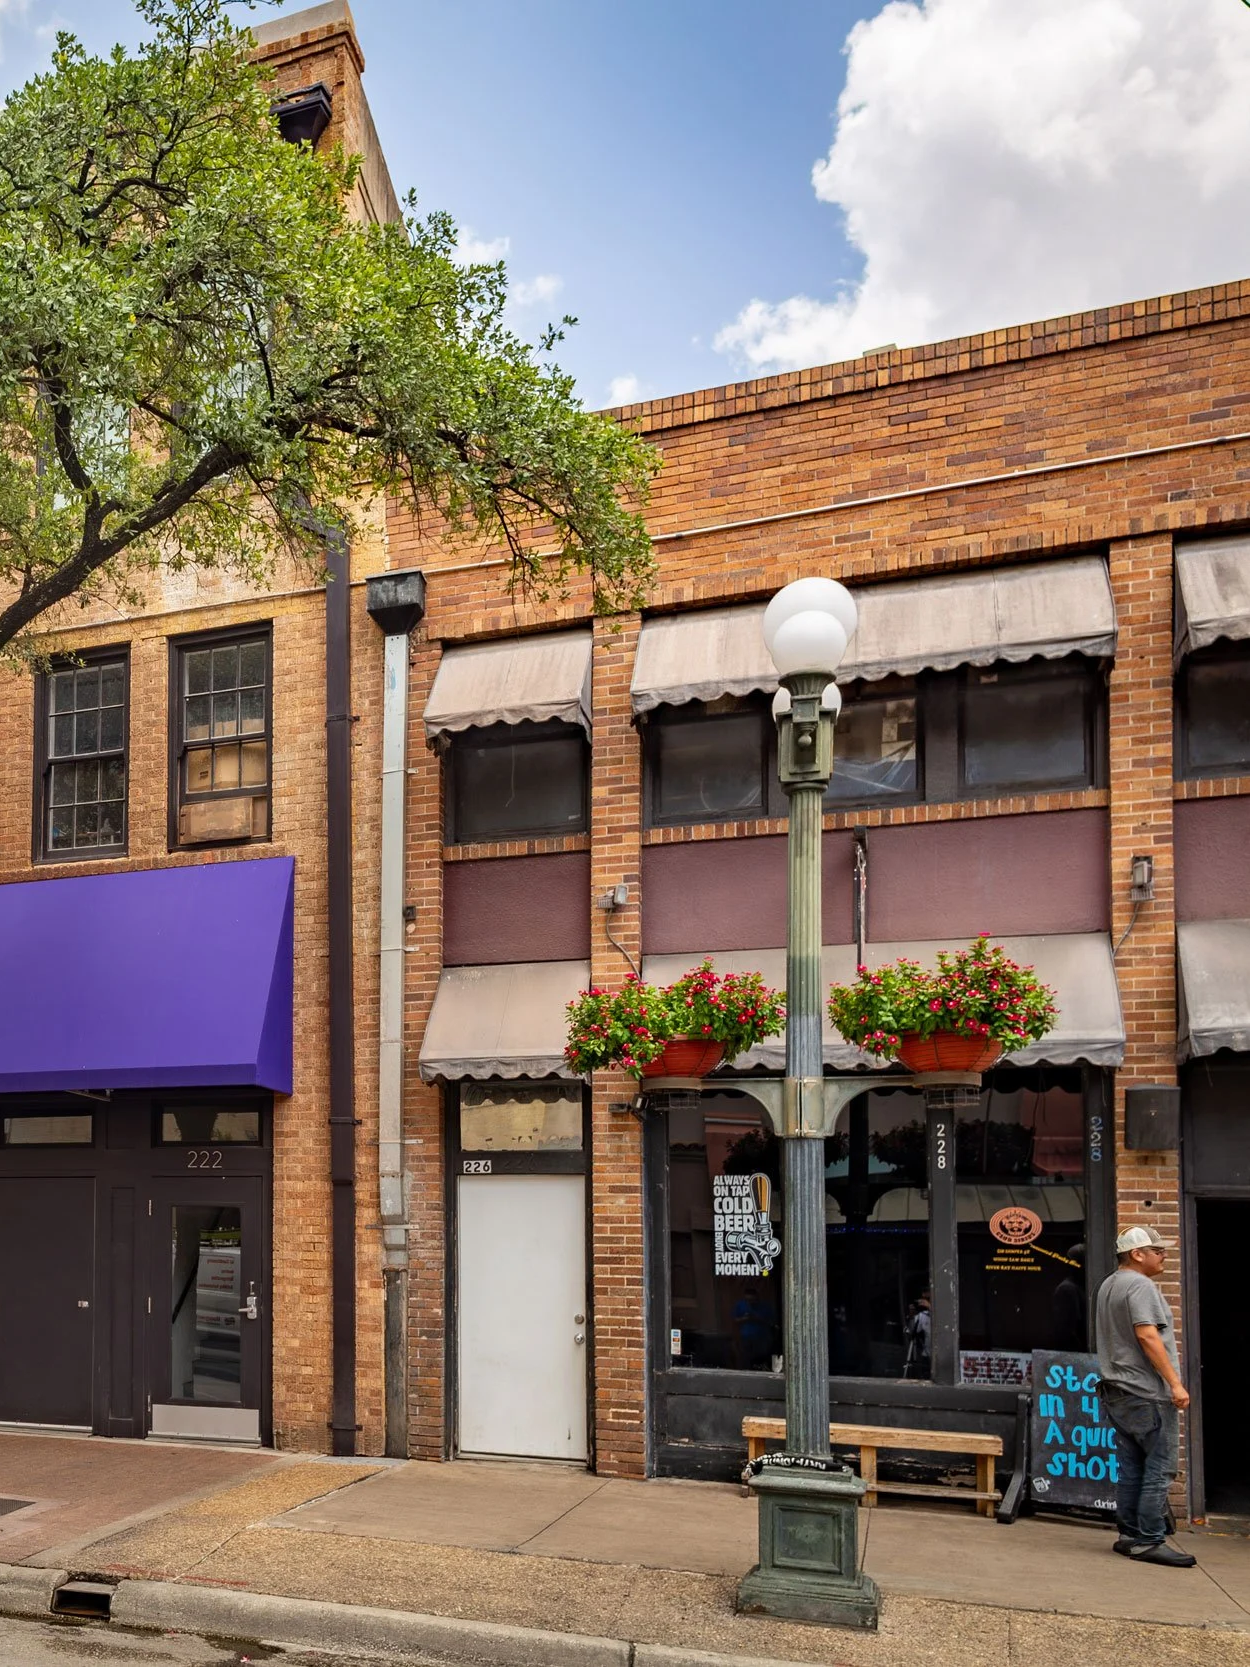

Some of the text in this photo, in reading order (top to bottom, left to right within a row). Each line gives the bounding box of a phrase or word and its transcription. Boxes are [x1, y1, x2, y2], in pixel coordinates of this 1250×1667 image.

[937, 1124, 946, 1169] 228
[187, 1150, 223, 1169] 222
[464, 1161, 490, 1173] 226
[713, 1175, 750, 1186] ALWAYS
[713, 1186, 750, 1197] ON TAP
[713, 1197, 753, 1214] COLD
[714, 1214, 755, 1232] BEER
[714, 1231, 724, 1252] ENJOY
[715, 1251, 749, 1263] EVERY
[715, 1264, 761, 1276] MOMENT
[1043, 1419, 1118, 1456] A quic
